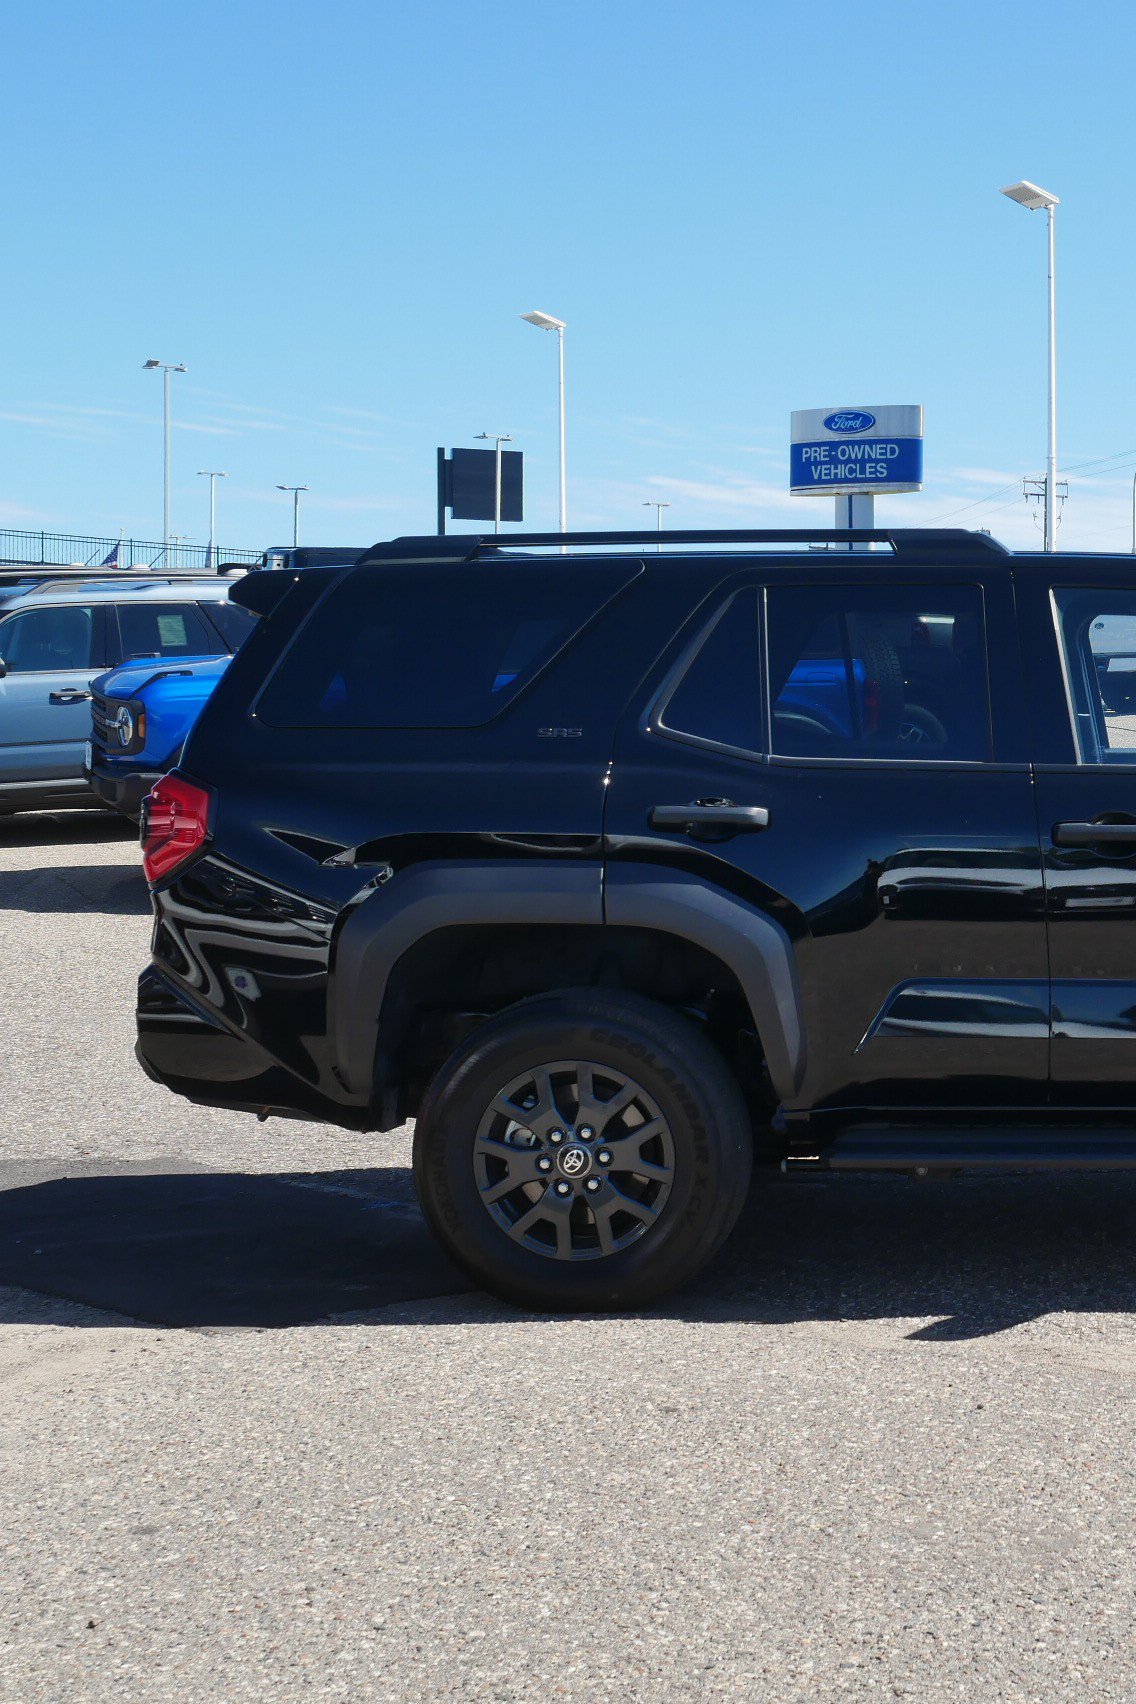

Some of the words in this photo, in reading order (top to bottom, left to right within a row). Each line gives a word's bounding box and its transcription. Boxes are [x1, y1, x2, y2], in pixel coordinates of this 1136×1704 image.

[832, 414, 862, 429] Ford
[811, 463, 888, 480] VEHICLES
[588, 1027, 711, 1165] GEOLANDAR
